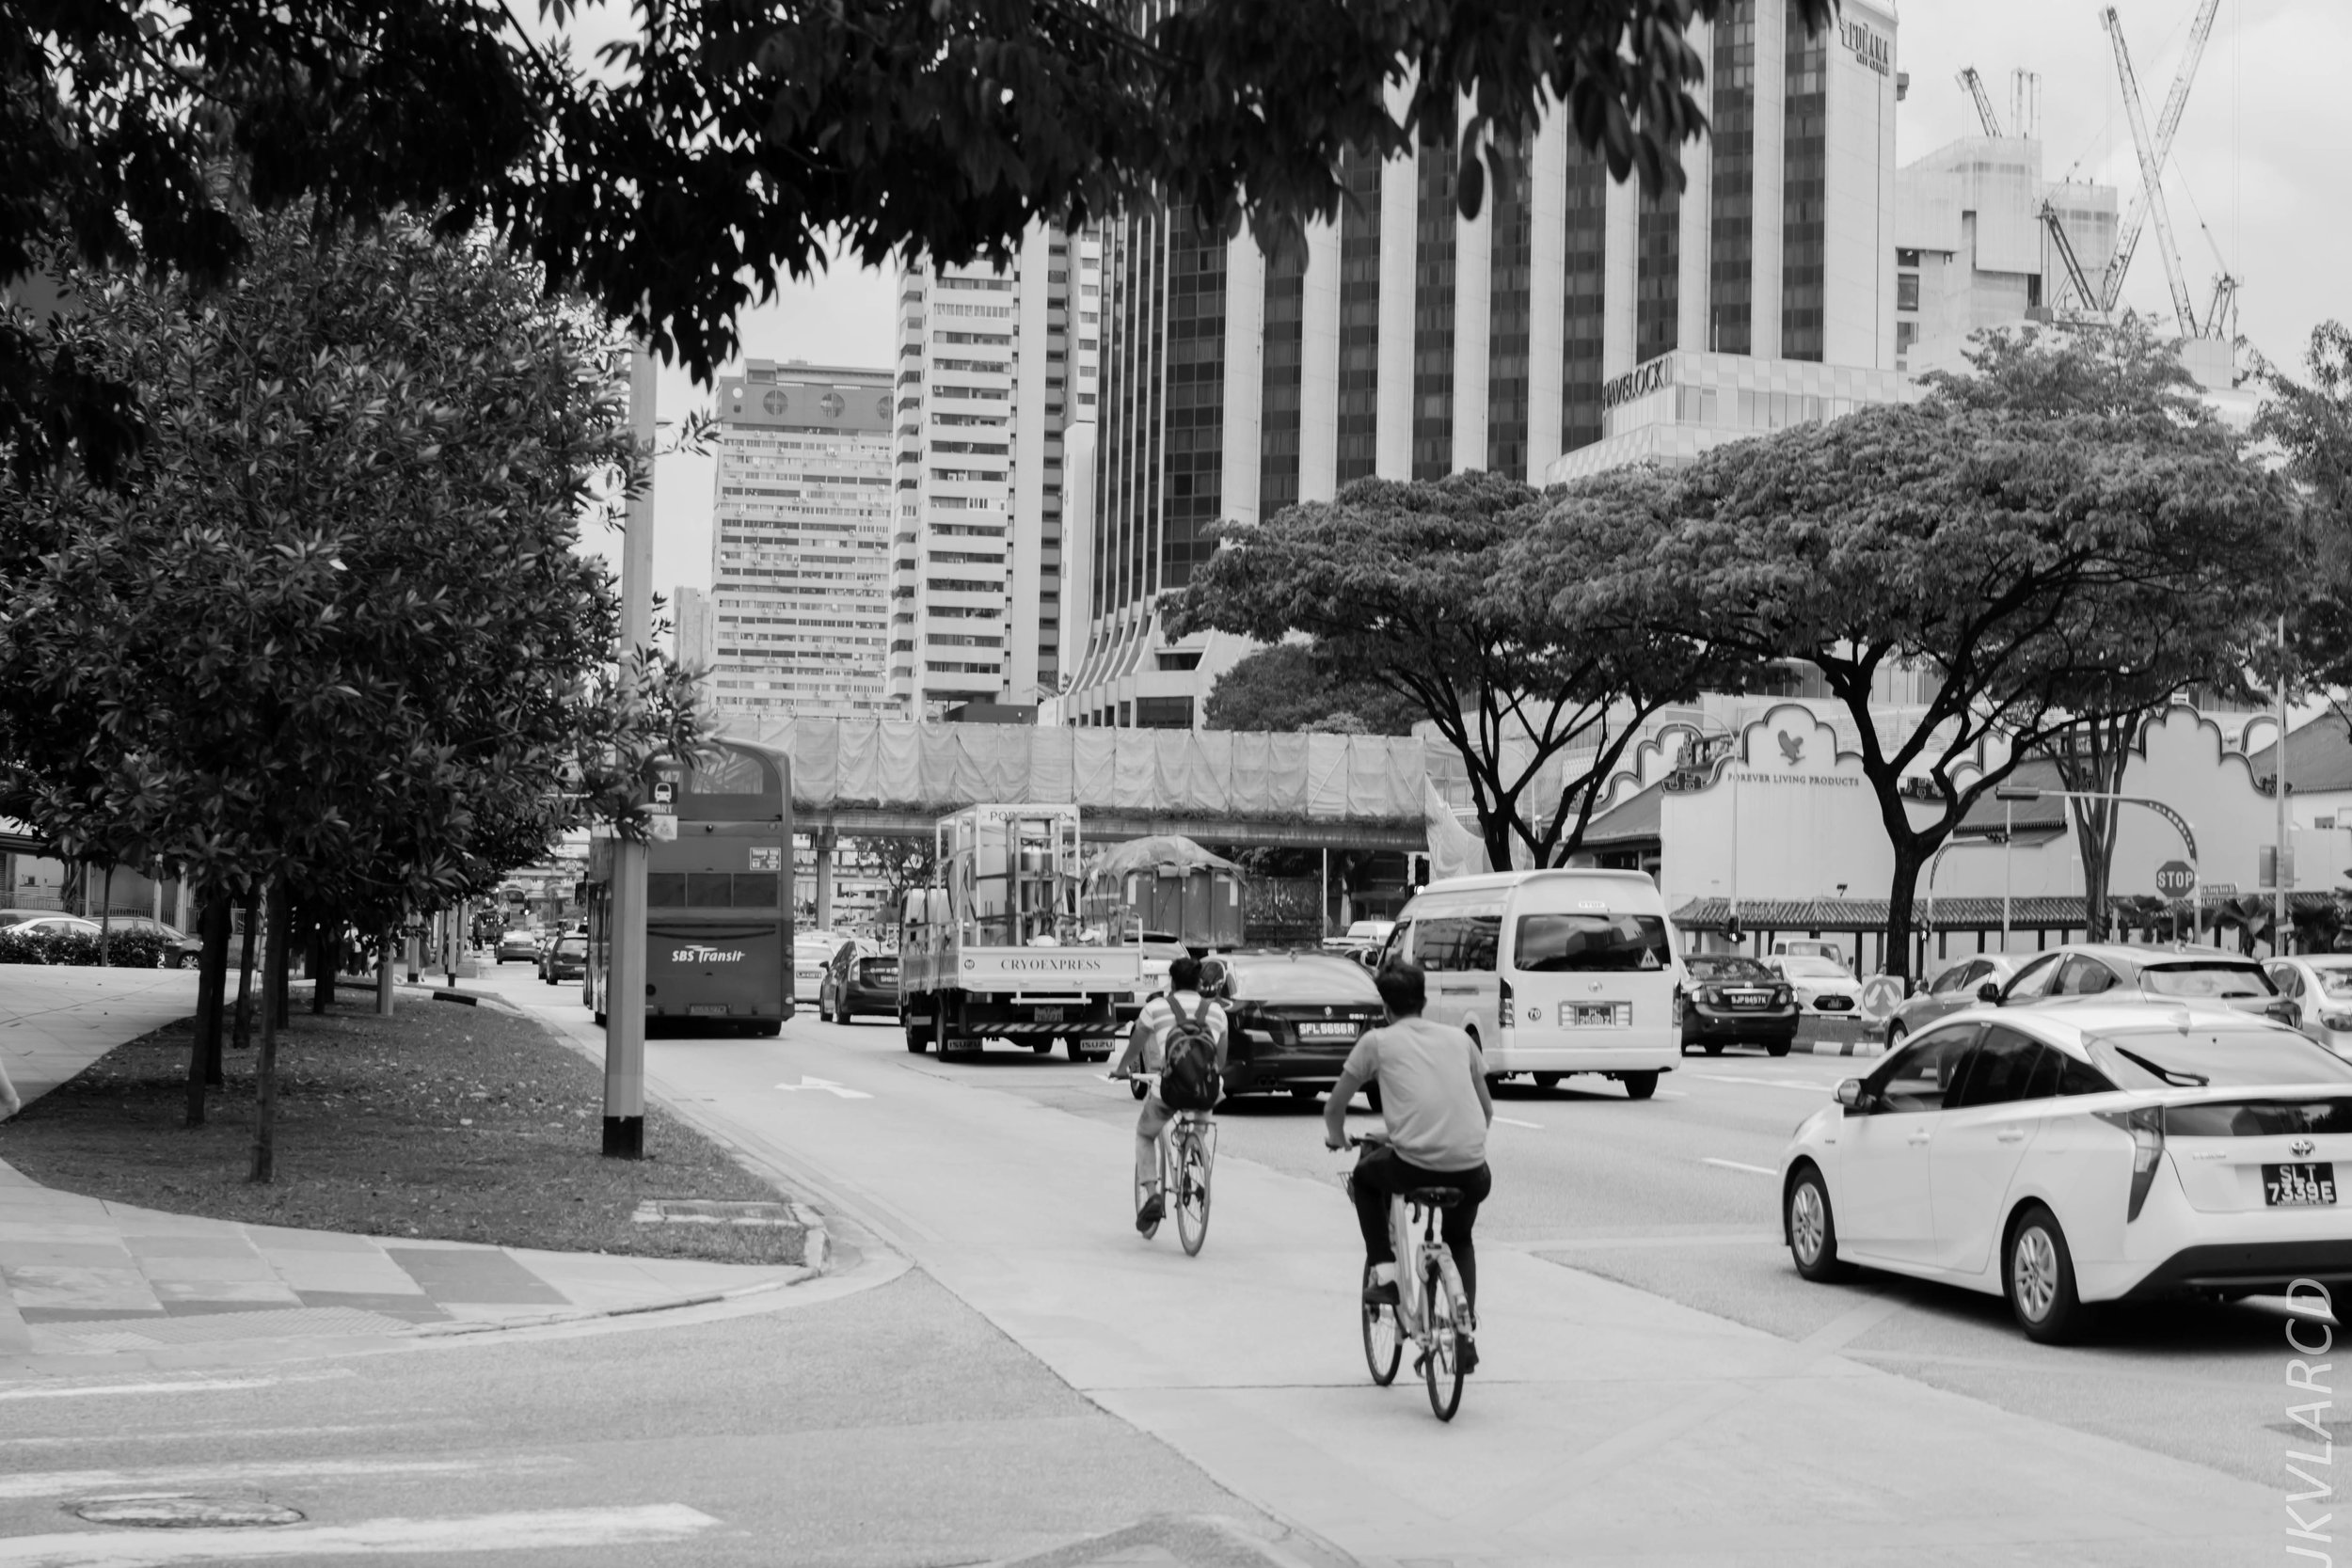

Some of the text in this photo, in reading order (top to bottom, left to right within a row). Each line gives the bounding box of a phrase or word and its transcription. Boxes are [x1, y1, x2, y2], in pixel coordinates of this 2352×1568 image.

[1603, 359, 1663, 411] HAVELOCK
[1774, 774, 1806, 784] LIVING
[1809, 776, 1859, 787] PRODUCTS
[2157, 871, 2194, 889] STOP
[672, 946, 745, 963] SBS Transit
[1001, 959, 1101, 971] CRYOEXPRESS
[949, 1041, 981, 1050] ISUZU
[1081, 1040, 1113, 1050] ISUZU
[2280, 1164, 2316, 1184] SLT
[2267, 1180, 2334, 1203] 7339E
